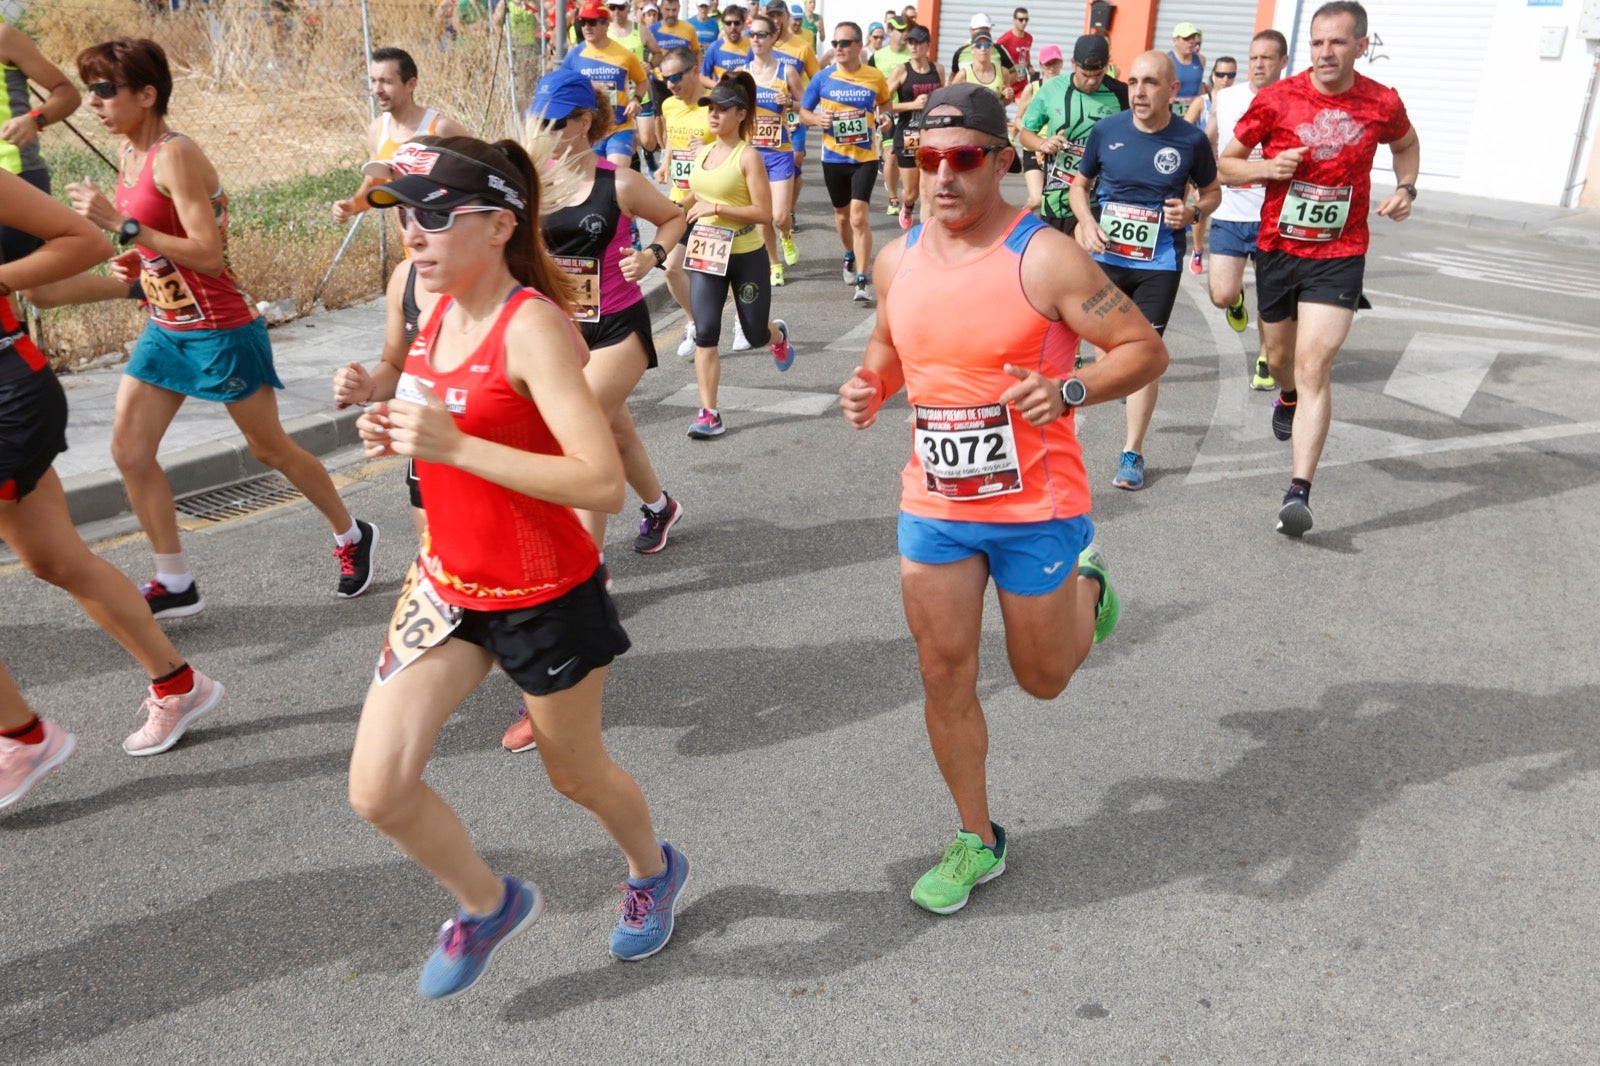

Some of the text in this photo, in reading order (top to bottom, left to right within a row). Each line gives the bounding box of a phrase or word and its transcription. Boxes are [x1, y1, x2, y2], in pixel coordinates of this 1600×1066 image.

[829, 88, 871, 101] agustinos
[839, 119, 863, 134] 843
[1296, 201, 1339, 224] 156
[1109, 220, 1149, 243] 266
[691, 239, 727, 259] 2114
[923, 432, 1007, 467] 3072
